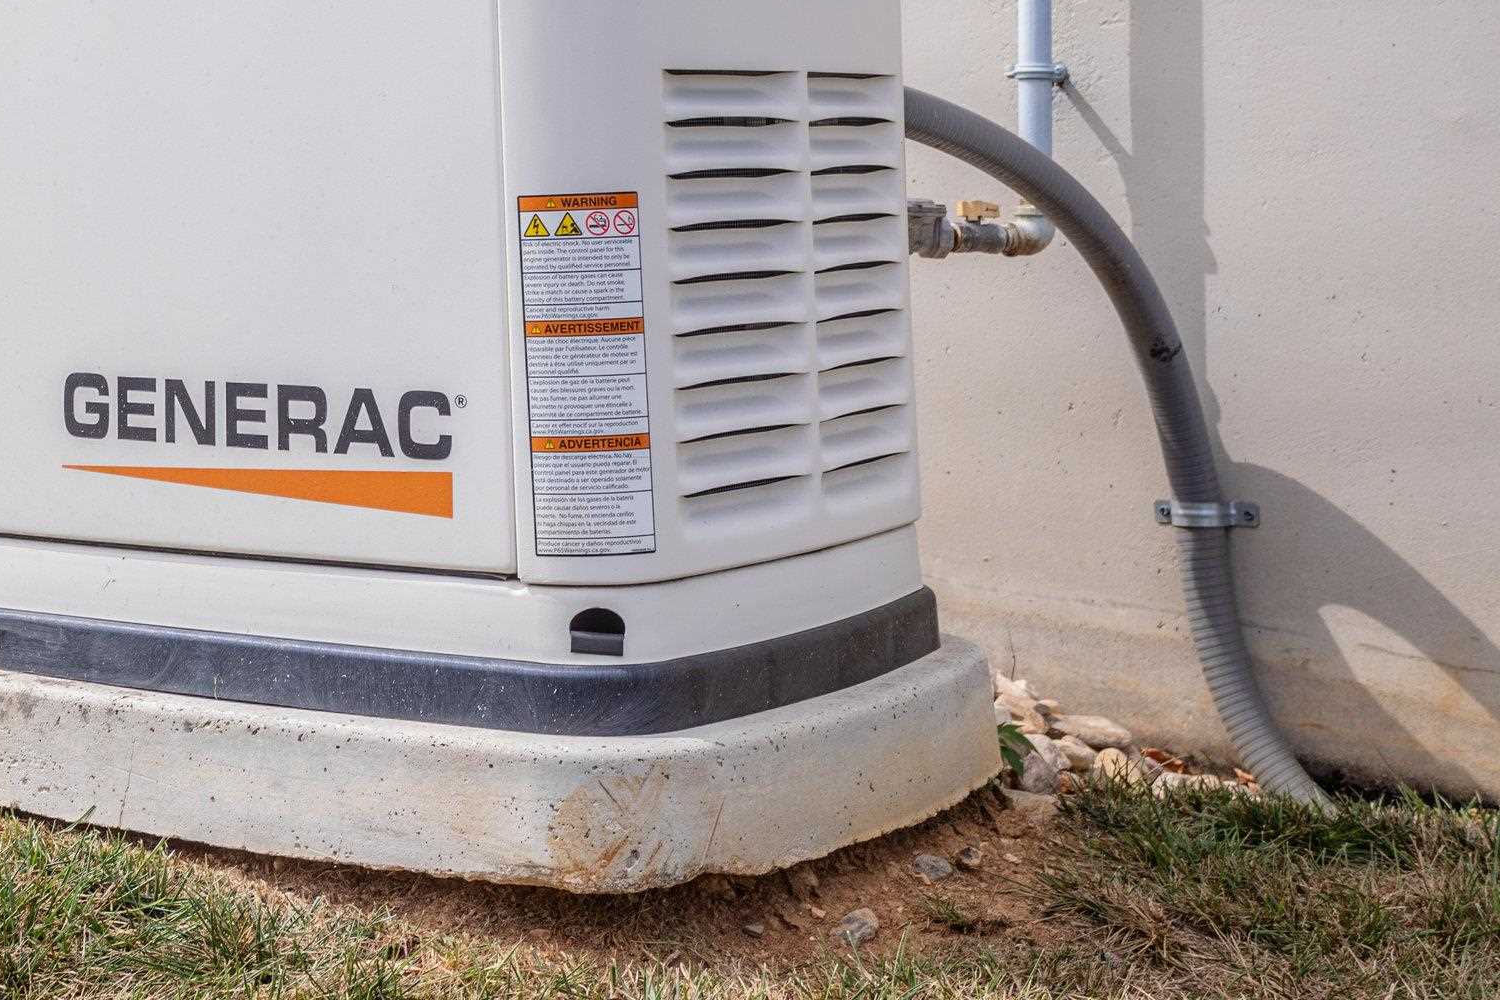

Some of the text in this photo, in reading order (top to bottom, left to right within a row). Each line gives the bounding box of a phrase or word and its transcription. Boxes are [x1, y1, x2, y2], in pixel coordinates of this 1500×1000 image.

[560, 196, 617, 208] WARNING
[545, 320, 641, 334] AVERTISSEMENT
[559, 437, 641, 449] ADVERTENCIA
